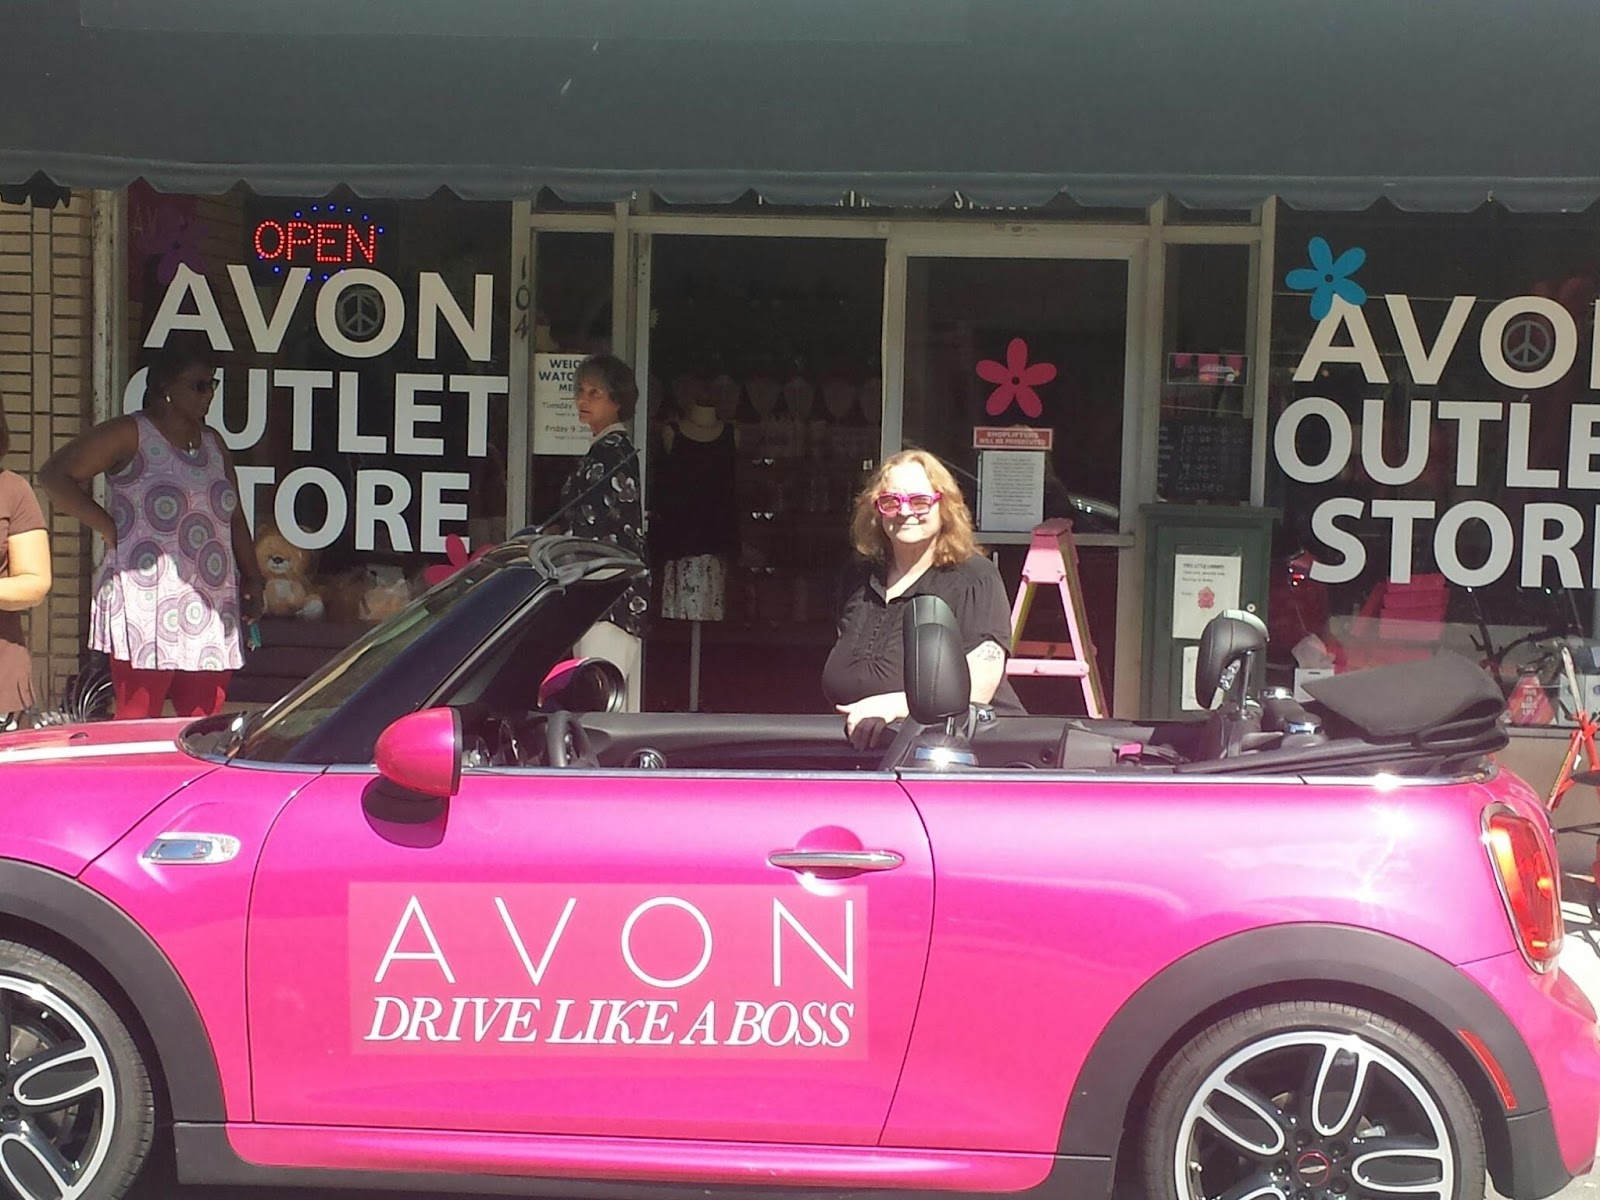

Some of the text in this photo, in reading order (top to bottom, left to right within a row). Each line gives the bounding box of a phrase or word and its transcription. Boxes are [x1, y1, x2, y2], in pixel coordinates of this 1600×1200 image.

[253, 220, 378, 264] OPEN
[143, 262, 494, 362] AVON
[514, 255, 530, 339] 104
[1292, 293, 1600, 390] AVO
[234, 465, 471, 555] TORE
[1309, 497, 1600, 590] STOR
[373, 894, 855, 990] AVON
[363, 995, 856, 1048] DRIVE LIKE A BOSS
